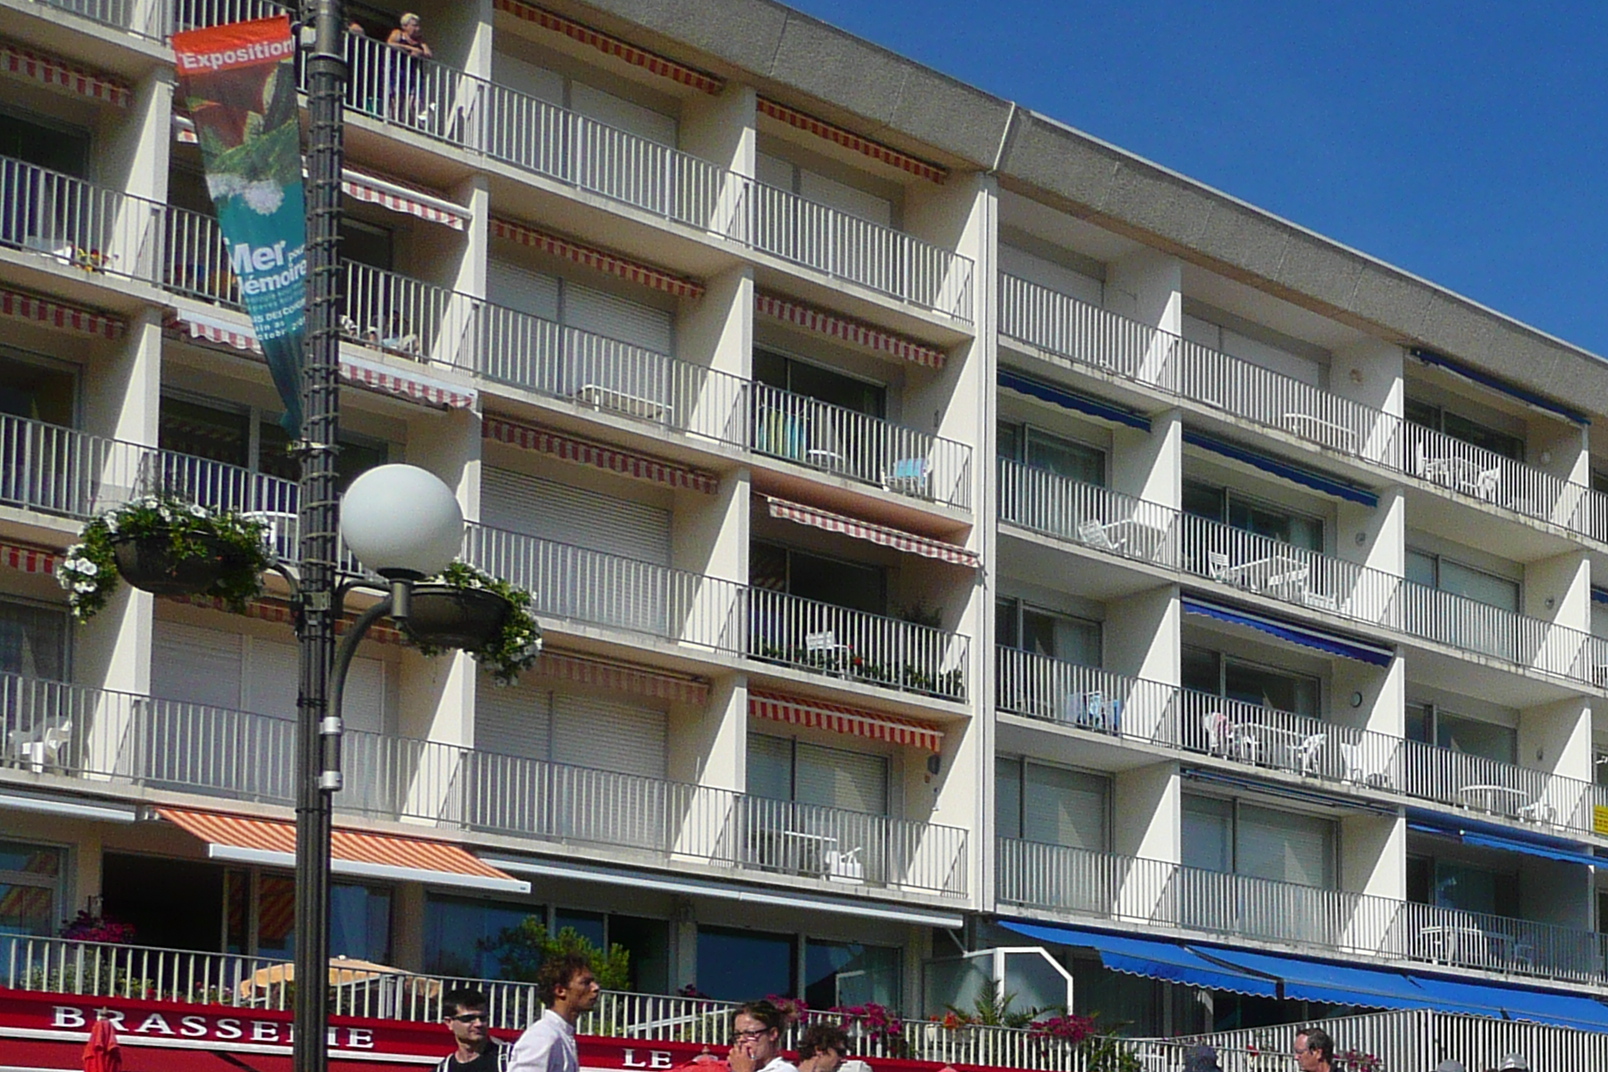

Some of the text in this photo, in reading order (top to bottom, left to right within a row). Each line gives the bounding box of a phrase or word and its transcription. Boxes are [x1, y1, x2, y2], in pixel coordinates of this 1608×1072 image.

[179, 39, 293, 69] Exposition
[238, 259, 307, 294] émoire
[622, 1048, 673, 1069] LE
